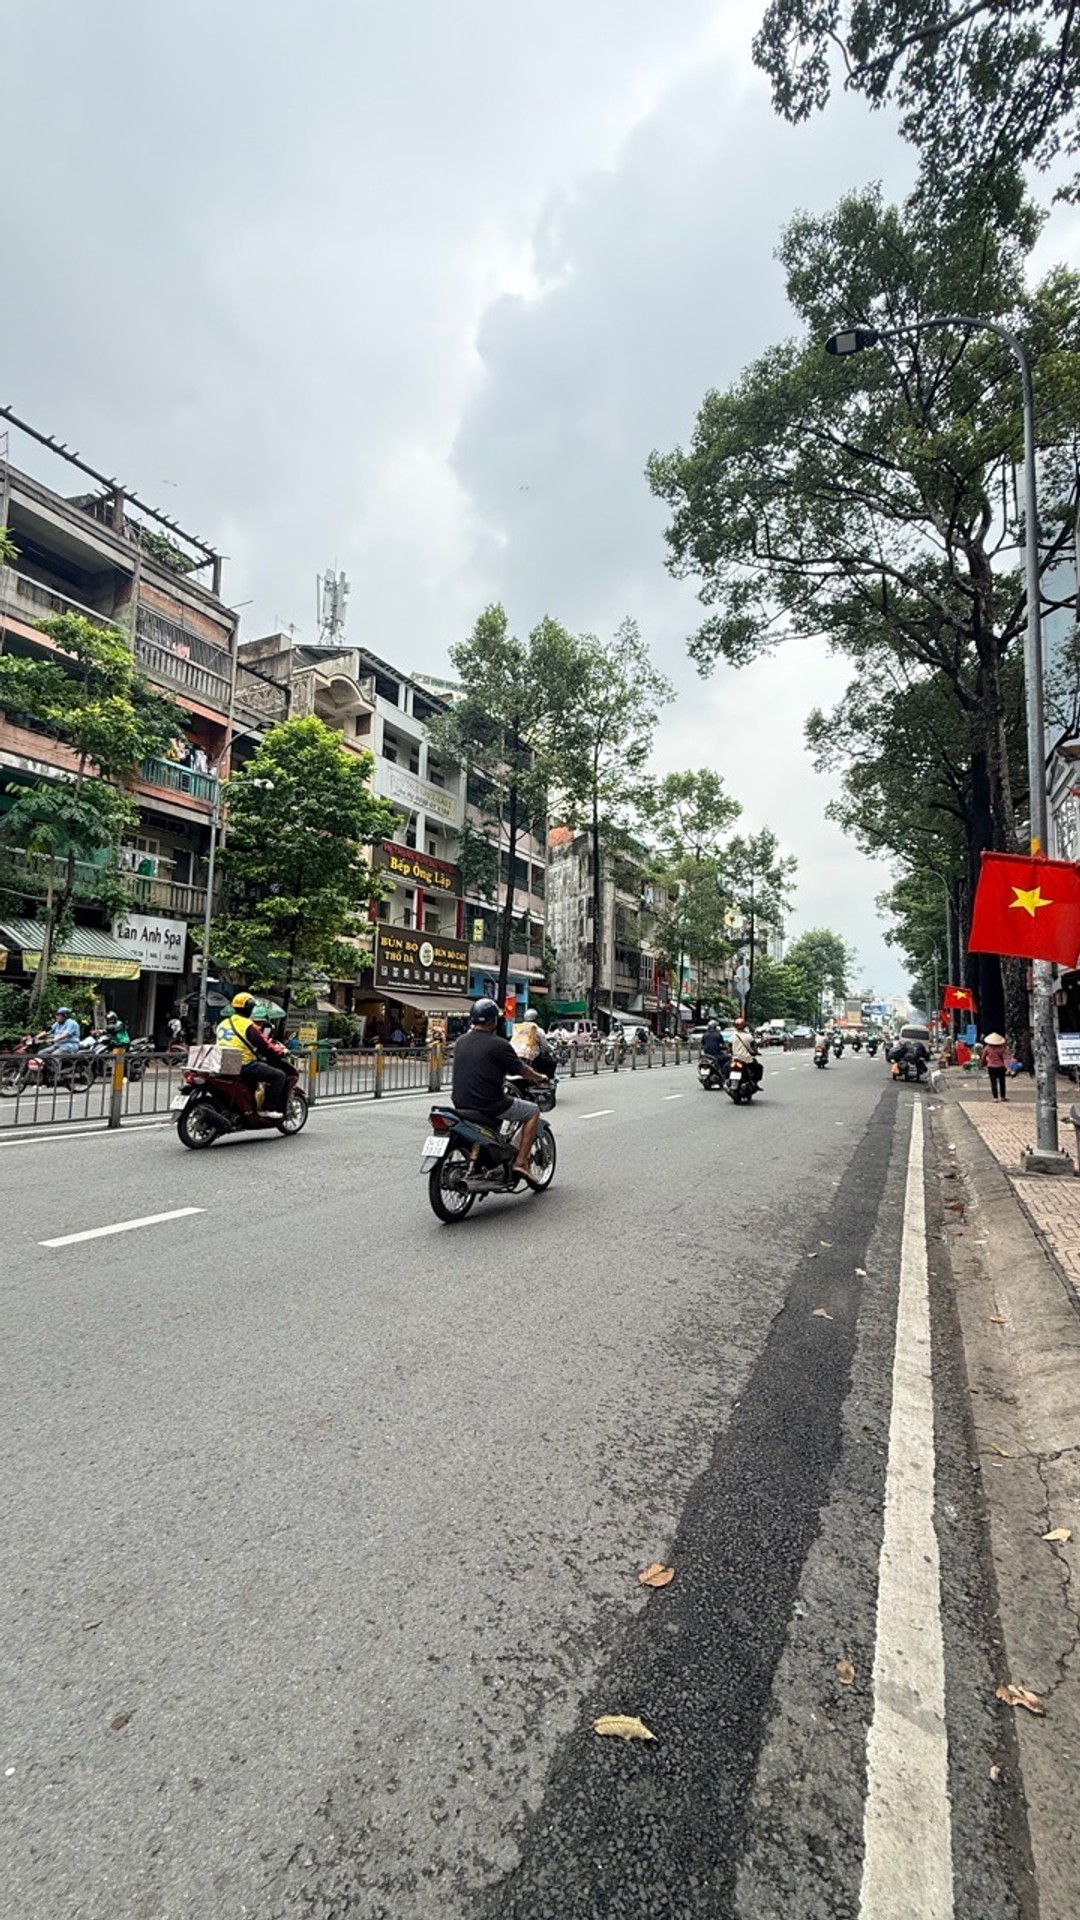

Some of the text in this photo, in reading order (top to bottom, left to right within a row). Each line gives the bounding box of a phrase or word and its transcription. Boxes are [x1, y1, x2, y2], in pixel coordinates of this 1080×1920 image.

[390, 857, 410, 876] Bếp
[412, 862, 432, 884] Ông
[140, 926, 162, 943] Anh
[163, 928, 182, 950] Spa
[380, 935, 402, 949] BÚN
